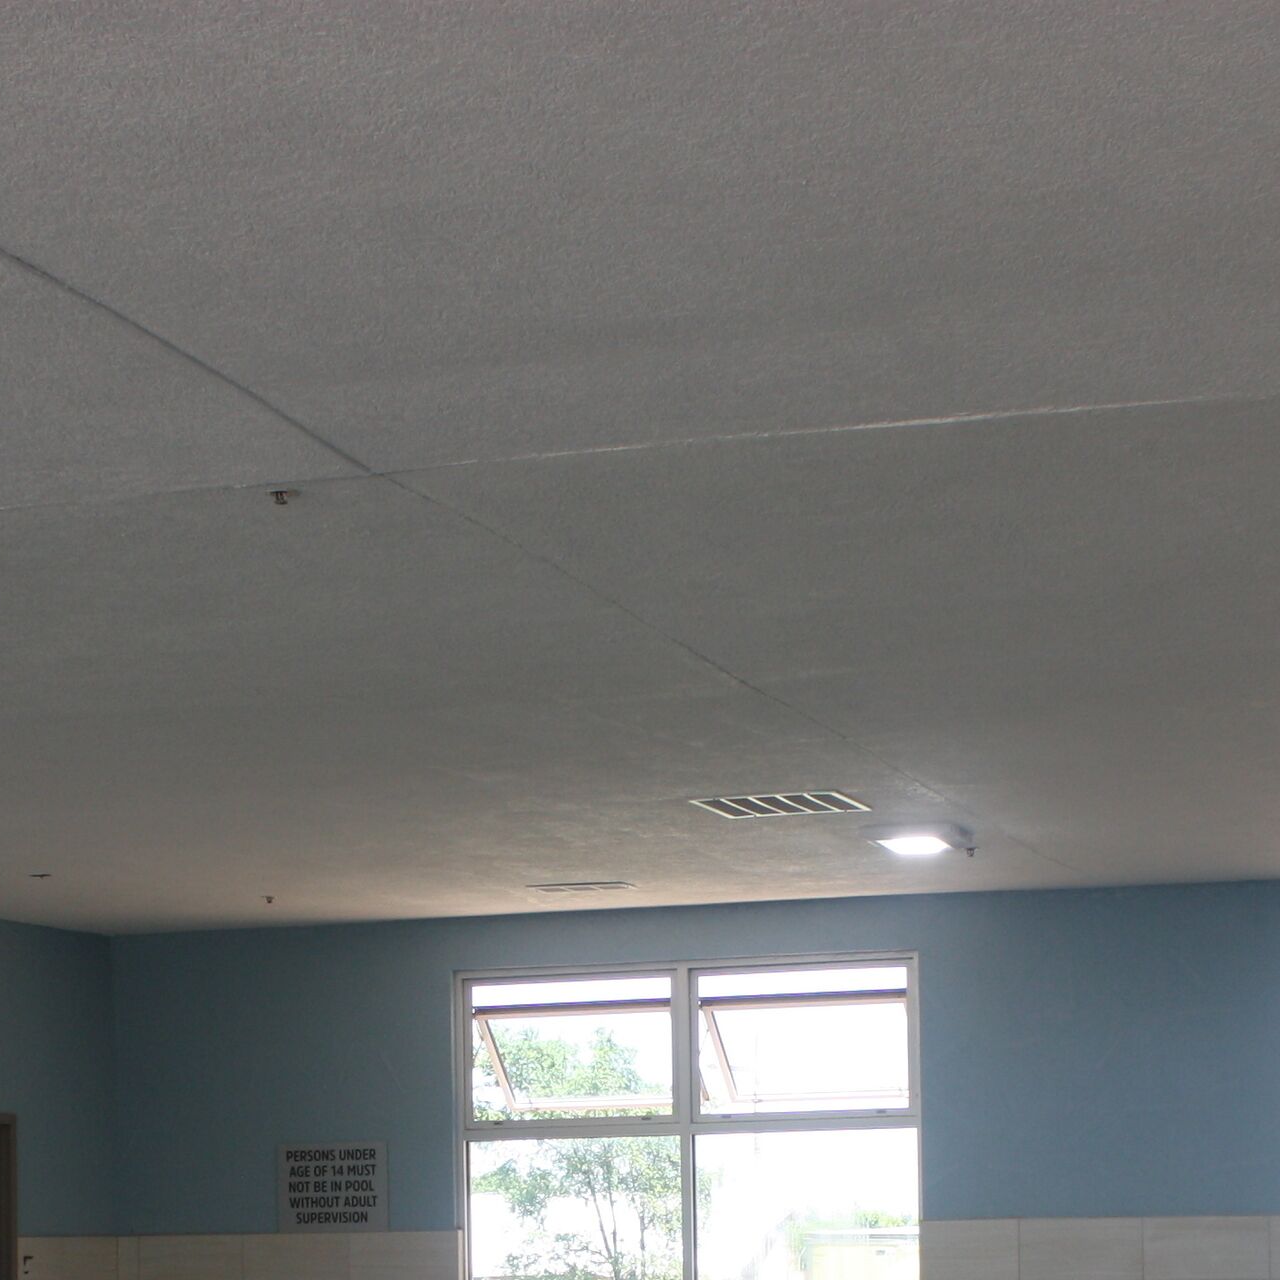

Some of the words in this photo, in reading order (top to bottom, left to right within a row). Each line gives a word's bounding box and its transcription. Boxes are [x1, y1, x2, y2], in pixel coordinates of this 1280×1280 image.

[286, 1149, 336, 1162] PERSONS
[339, 1148, 376, 1161] UNDER
[289, 1165, 311, 1178] AGE
[313, 1165, 328, 1177] OF
[331, 1165, 344, 1177] 14
[347, 1164, 376, 1177] MUST
[288, 1181, 311, 1193] NOT
[313, 1181, 328, 1193] BE
[330, 1180, 342, 1192] IN
[345, 1180, 375, 1192] POOL
[289, 1196, 340, 1209] WITHOUT
[344, 1195, 377, 1208] ADULT
[295, 1211, 369, 1224] SUPERVISION
